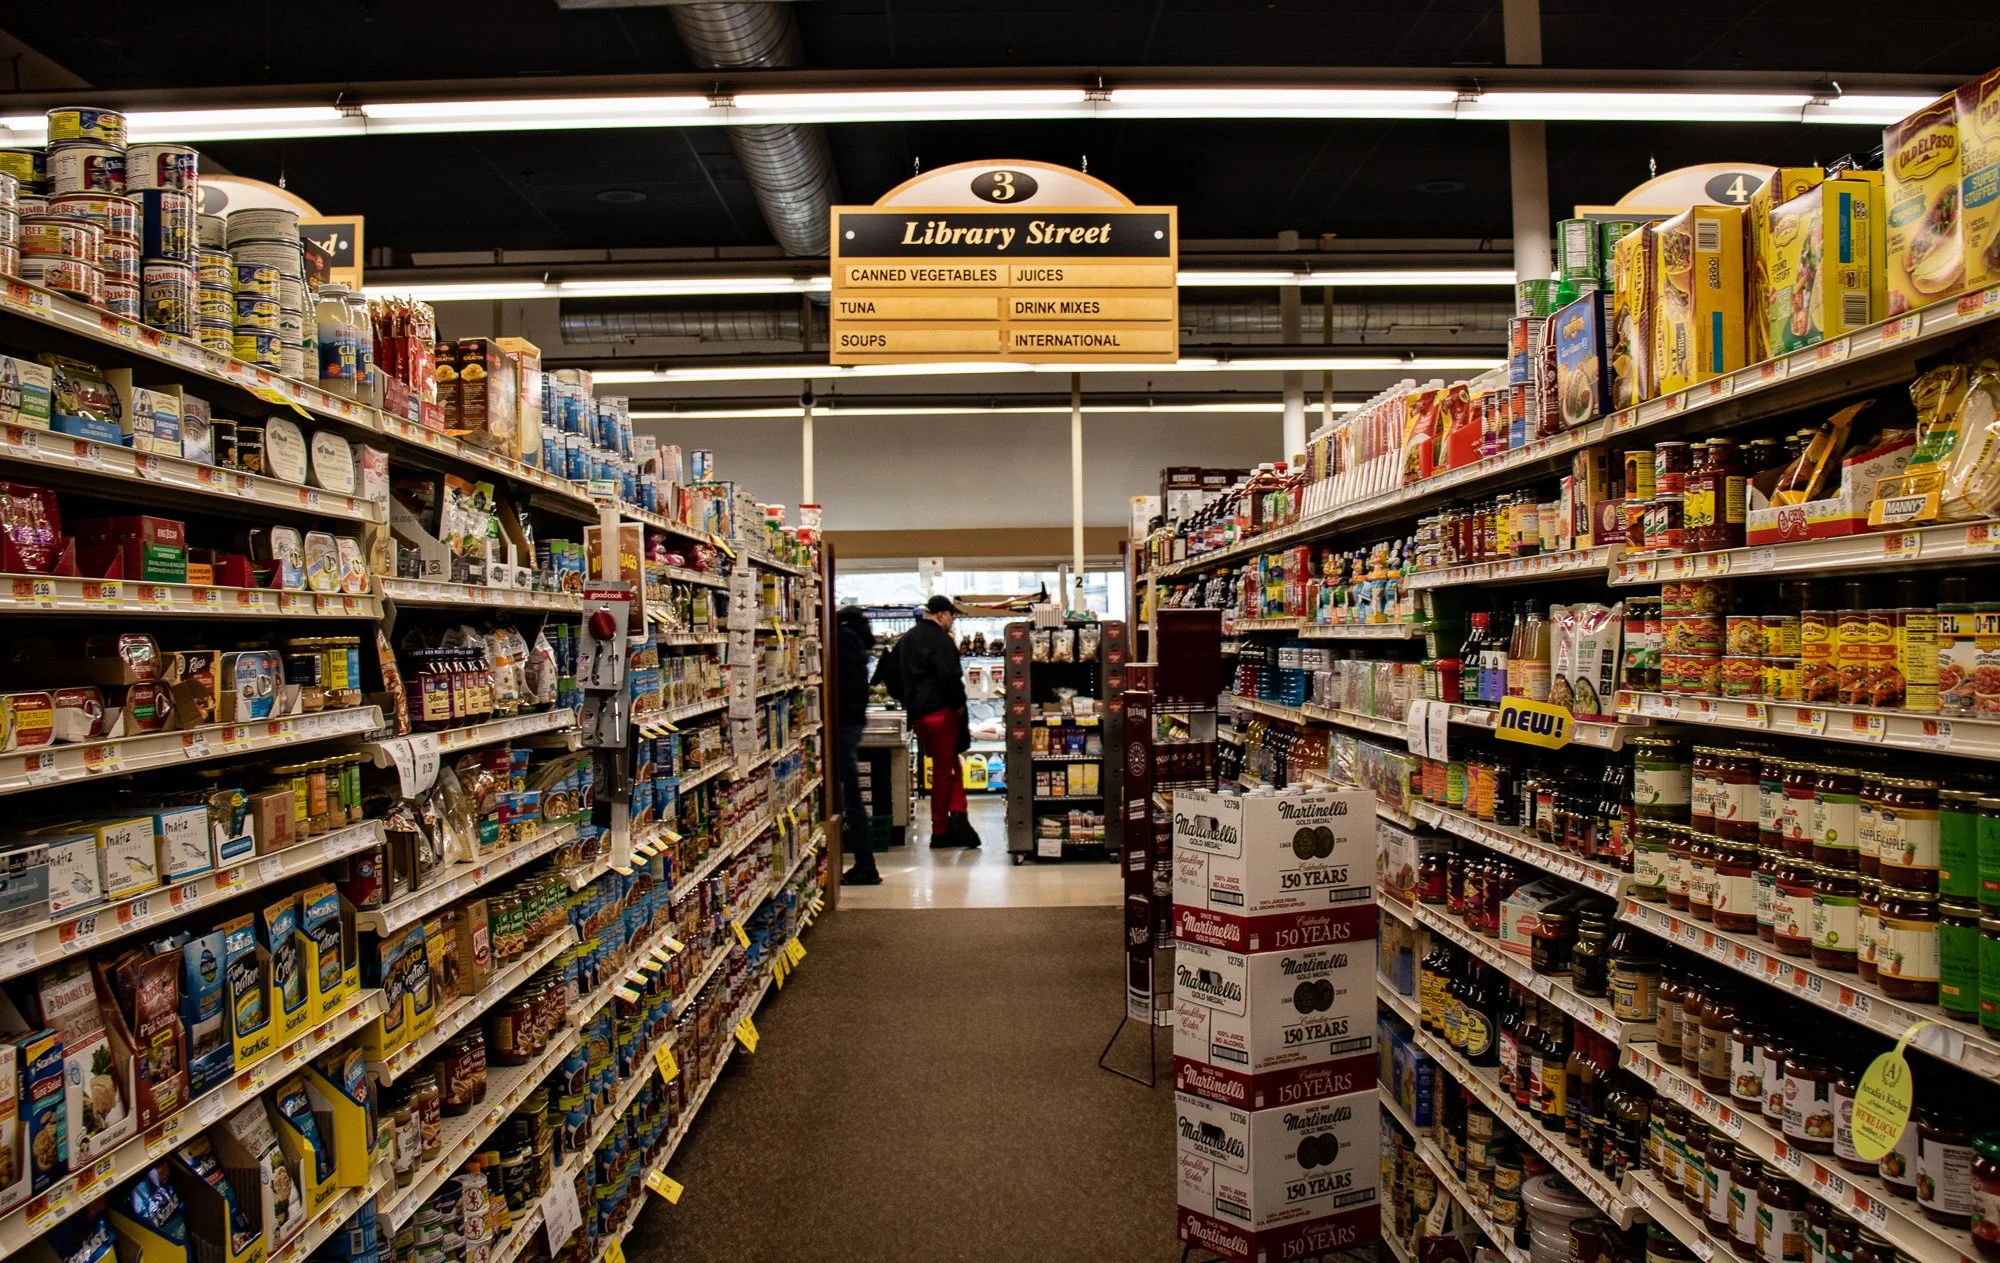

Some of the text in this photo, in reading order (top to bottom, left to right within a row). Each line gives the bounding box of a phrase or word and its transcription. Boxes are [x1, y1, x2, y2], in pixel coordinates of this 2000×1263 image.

[1900, 148, 1916, 168] OLD
[1918, 139, 1929, 155] EL
[992, 171, 1016, 200] 3
[1971, 168, 1999, 188] SUPER
[1726, 175, 1748, 203] 4
[1964, 184, 1999, 206] STUFFER
[25, 226, 43, 235] BEE
[902, 221, 1112, 250] Library Street
[851, 269, 997, 282] CANNED VEGETABLES
[1017, 269, 1063, 282] JUICES
[1771, 261, 1787, 275] STAND
[840, 302, 876, 314] TUNA
[1015, 302, 1100, 314] DRINK MIXES
[841, 335, 886, 347] SOUPS
[1015, 335, 1120, 347] INTERNATIONAL
[621, 553, 638, 571] BAGS
[1075, 577, 1083, 588] 2
[590, 590, 623, 600] goodcook
[1501, 707, 1563, 738] NEW!
[1224, 799, 1240, 810] 12756
[165, 816, 188, 836] matiz
[106, 828, 131, 849] matiz
[1190, 837, 1222, 849] GOLD MEDAL
[1175, 851, 1205, 868] Sparkling
[1181, 864, 1198, 878] Cider
[1281, 869, 1348, 889] 150 YEARS
[109, 875, 132, 888] SARDINES
[1220, 883, 1240, 891] ALCOHOL
[1227, 876, 1240, 884] JUICE
[50, 890, 71, 901] SARDINES
[132, 901, 148, 918] 4.19
[76, 918, 96, 935] 4.59
[1275, 922, 1351, 947] 150 YEARS
[1227, 956, 1244, 968] 12756
[1808, 977, 1822, 992] 4.59
[322, 993, 342, 1014] StarKist
[1191, 991, 1226, 1005] GOLD MEDAL
[285, 1010, 308, 1033] StarKist
[1175, 1003, 1206, 1023] Sparkling
[1181, 1017, 1199, 1031] Cider
[1284, 1020, 1348, 1045] 150 YEARS
[239, 1036, 270, 1061] StarKist
[1886, 1063, 1896, 1080] A
[1279, 1073, 1352, 1102] 150 YEARS
[1229, 1111, 1247, 1125] 12756
[1876, 1117, 1896, 1137] LOCAL
[1194, 1143, 1229, 1161] GOLD MEDAL
[1287, 1173, 1352, 1200] 150 YEARS
[1829, 1175, 1844, 1194] 5.59
[314, 1183, 337, 1208] StarKist
[1870, 1202, 1886, 1221] 5.59
[1282, 1225, 1355, 1258] 150 YEARS
